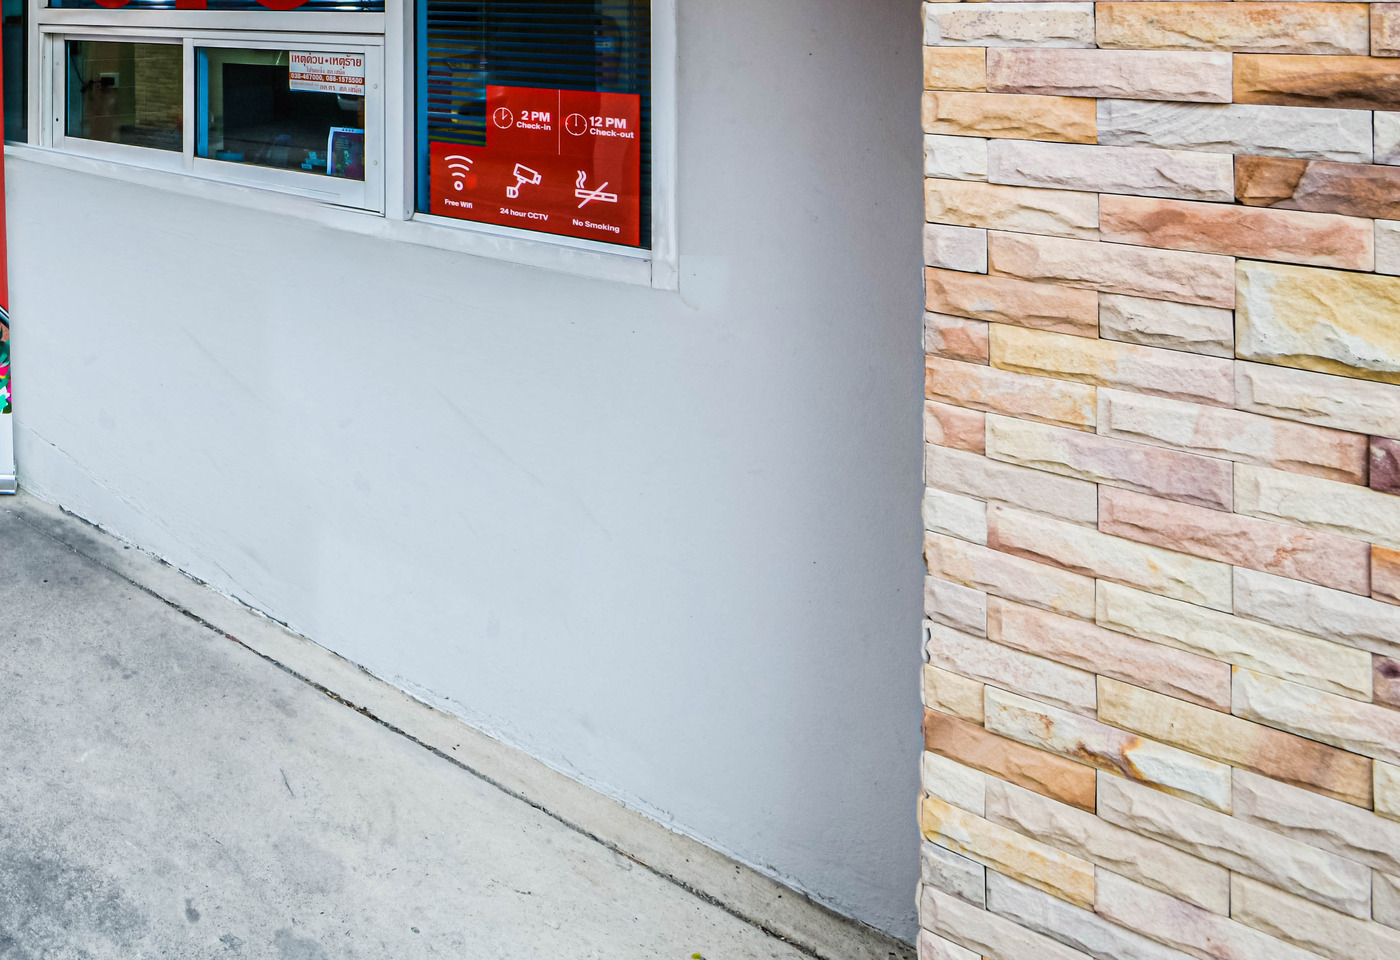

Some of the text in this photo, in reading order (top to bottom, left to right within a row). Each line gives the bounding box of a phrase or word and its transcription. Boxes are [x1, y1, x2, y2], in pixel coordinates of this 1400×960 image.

[291, 53, 362, 69] เหตุด่วน เหตุร้าย
[521, 111, 550, 123] 2 PM
[589, 116, 627, 129] 12 PM
[516, 121, 552, 132] Check-in
[589, 127, 635, 139] Check-out
[444, 198, 461, 207] Free
[500, 207, 549, 221] 24 hour CCTV
[572, 218, 620, 234] No Smoking
